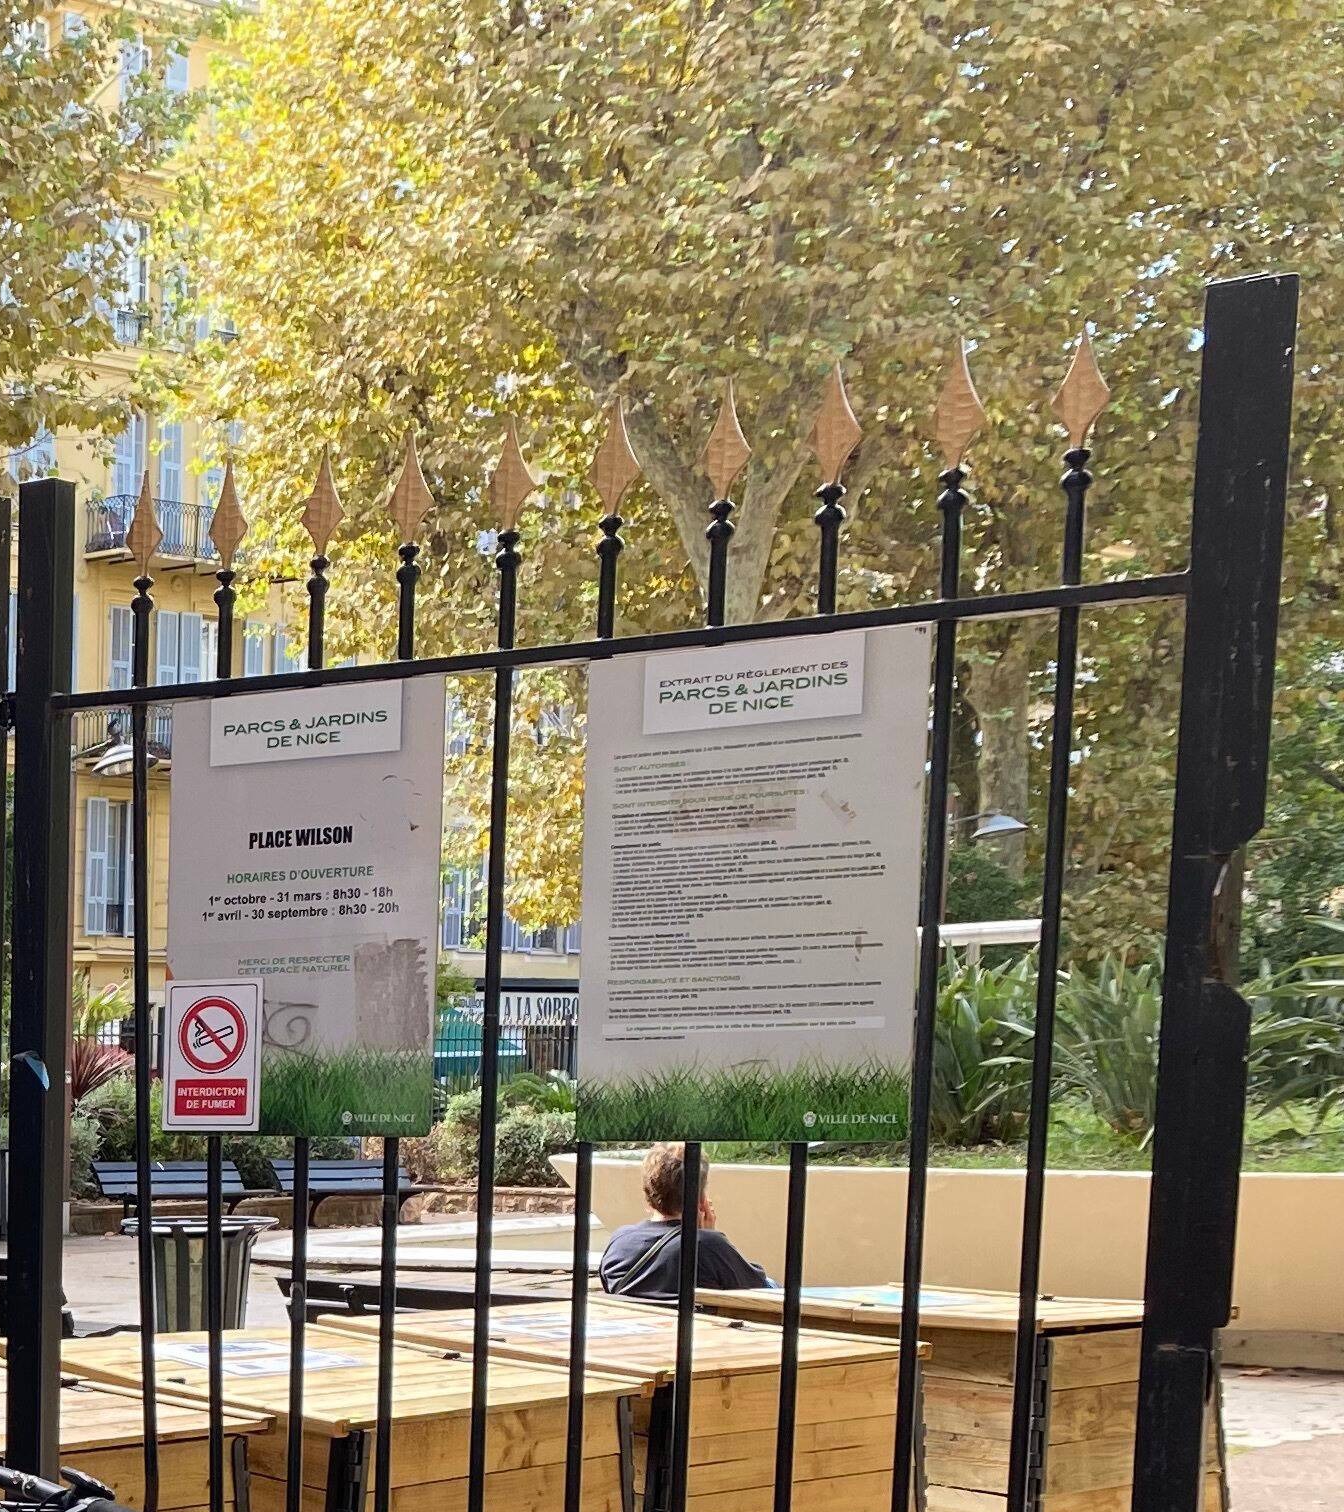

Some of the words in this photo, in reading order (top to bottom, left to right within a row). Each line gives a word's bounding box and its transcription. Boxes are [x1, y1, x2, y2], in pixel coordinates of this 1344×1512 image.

[659, 675, 712, 688] EXTRAIT
[714, 672, 735, 682] DU
[737, 662, 818, 680] RÈGLEMENT
[820, 660, 850, 671] DES
[658, 685, 731, 704] PARCS
[734, 683, 749, 696] &
[753, 672, 849, 694] JARDINS
[708, 701, 738, 715] DE
[742, 695, 795, 712] NICE
[223, 719, 286, 737] PARCS
[289, 718, 302, 731] &
[305, 710, 389, 730] JARDINS
[266, 735, 293, 749] DE
[296, 731, 342, 747] NICE
[248, 829, 293, 850] PLACE
[295, 825, 354, 847] WILSON
[227, 870, 287, 884] HORAIRES
[289, 865, 375, 882] D'OUVERTURE
[224, 894, 267, 906] octobre
[277, 891, 290, 903] 31
[293, 891, 322, 902] mars
[332, 887, 361, 900] 8h30
[372, 886, 394, 898] 18h
[217, 909, 242, 922] avril
[251, 909, 265, 920] 30
[267, 906, 329, 922] septembre
[338, 903, 367, 916] 8h30
[377, 902, 400, 914] 20h
[237, 966, 258, 975] CET
[259, 965, 300, 975] ESPACE
[302, 963, 351, 974] NATUREL
[238, 956, 271, 966] MERCI
[272, 956, 286, 965] DE
[288, 954, 351, 965] RESPECTER
[177, 1085, 245, 1097] INTERDICTION
[186, 1099, 200, 1109] DE
[201, 1098, 236, 1109] FUMER
[353, 1113, 378, 1123] VILLE
[817, 1114, 850, 1125] VILLE
[851, 1113, 868, 1124] DE
[869, 1113, 899, 1124] NICE
